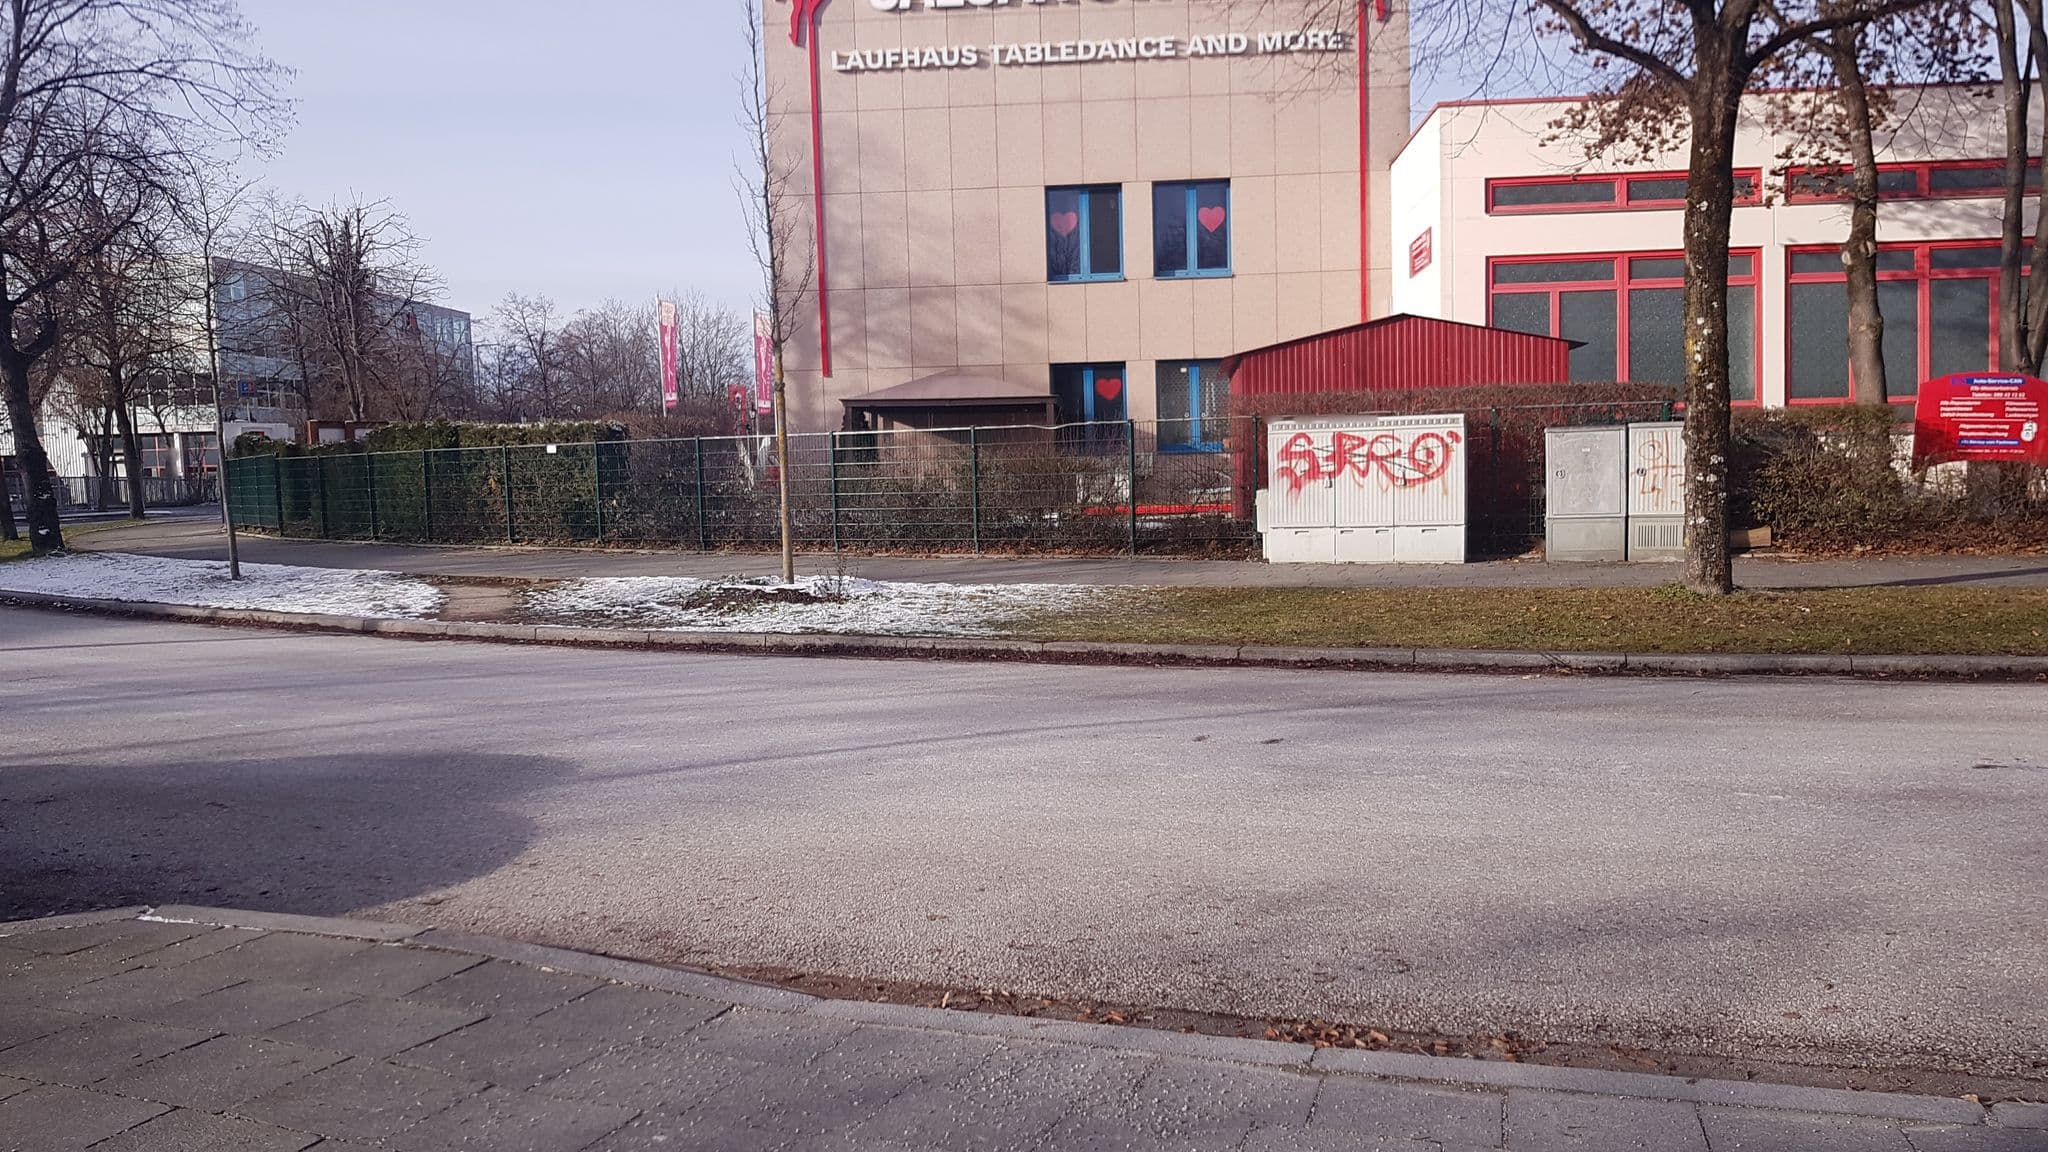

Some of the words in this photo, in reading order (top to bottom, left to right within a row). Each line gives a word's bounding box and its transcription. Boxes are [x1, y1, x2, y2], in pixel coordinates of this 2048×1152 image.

[831, 45, 978, 70] LAUFHAUS
[991, 35, 1176, 65] TABLEDANCE
[1186, 32, 1249, 55] AND
[1258, 28, 1344, 52] MORE
